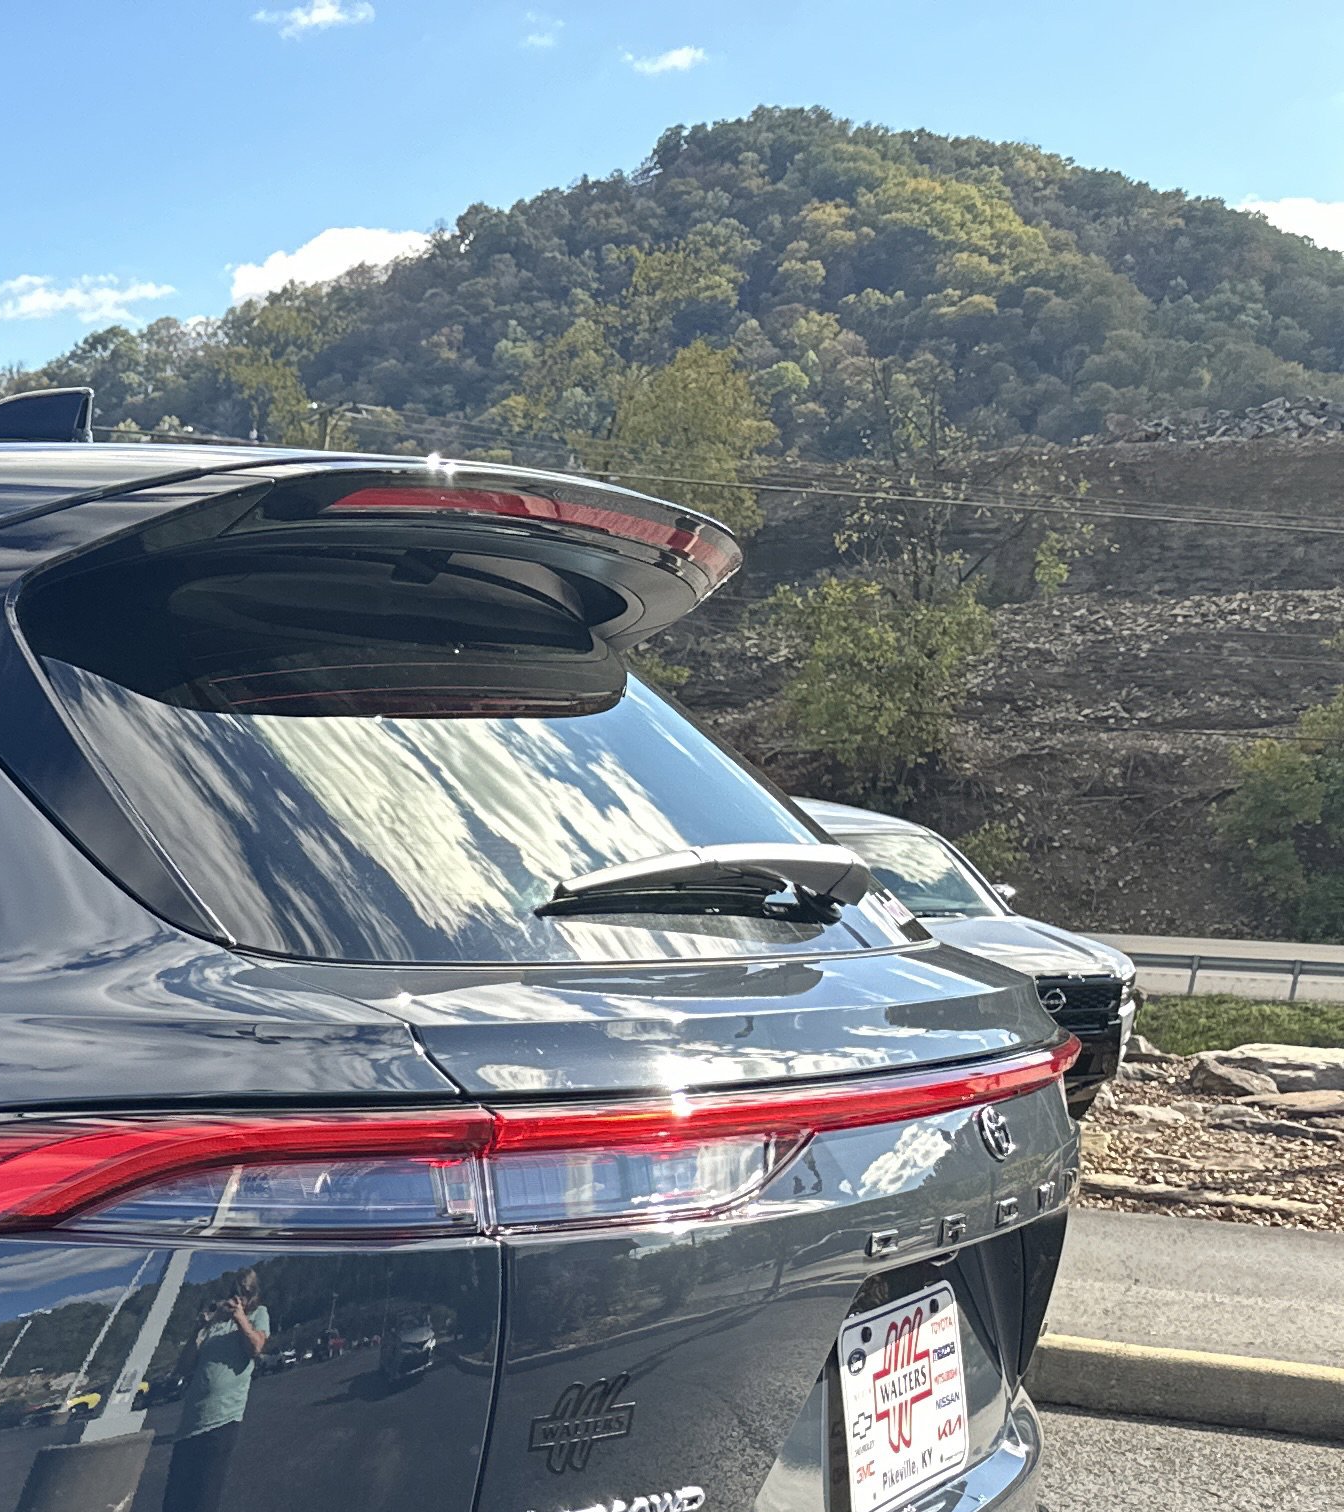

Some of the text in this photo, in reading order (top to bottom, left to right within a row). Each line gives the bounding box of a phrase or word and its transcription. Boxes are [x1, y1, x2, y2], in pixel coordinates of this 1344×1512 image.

[879, 1364, 927, 1404] WALTERS
[935, 1391, 961, 1411] NISSAN
[542, 1414, 625, 1440] WALTERS
[882, 1446, 933, 1491] Pikeville, KY
